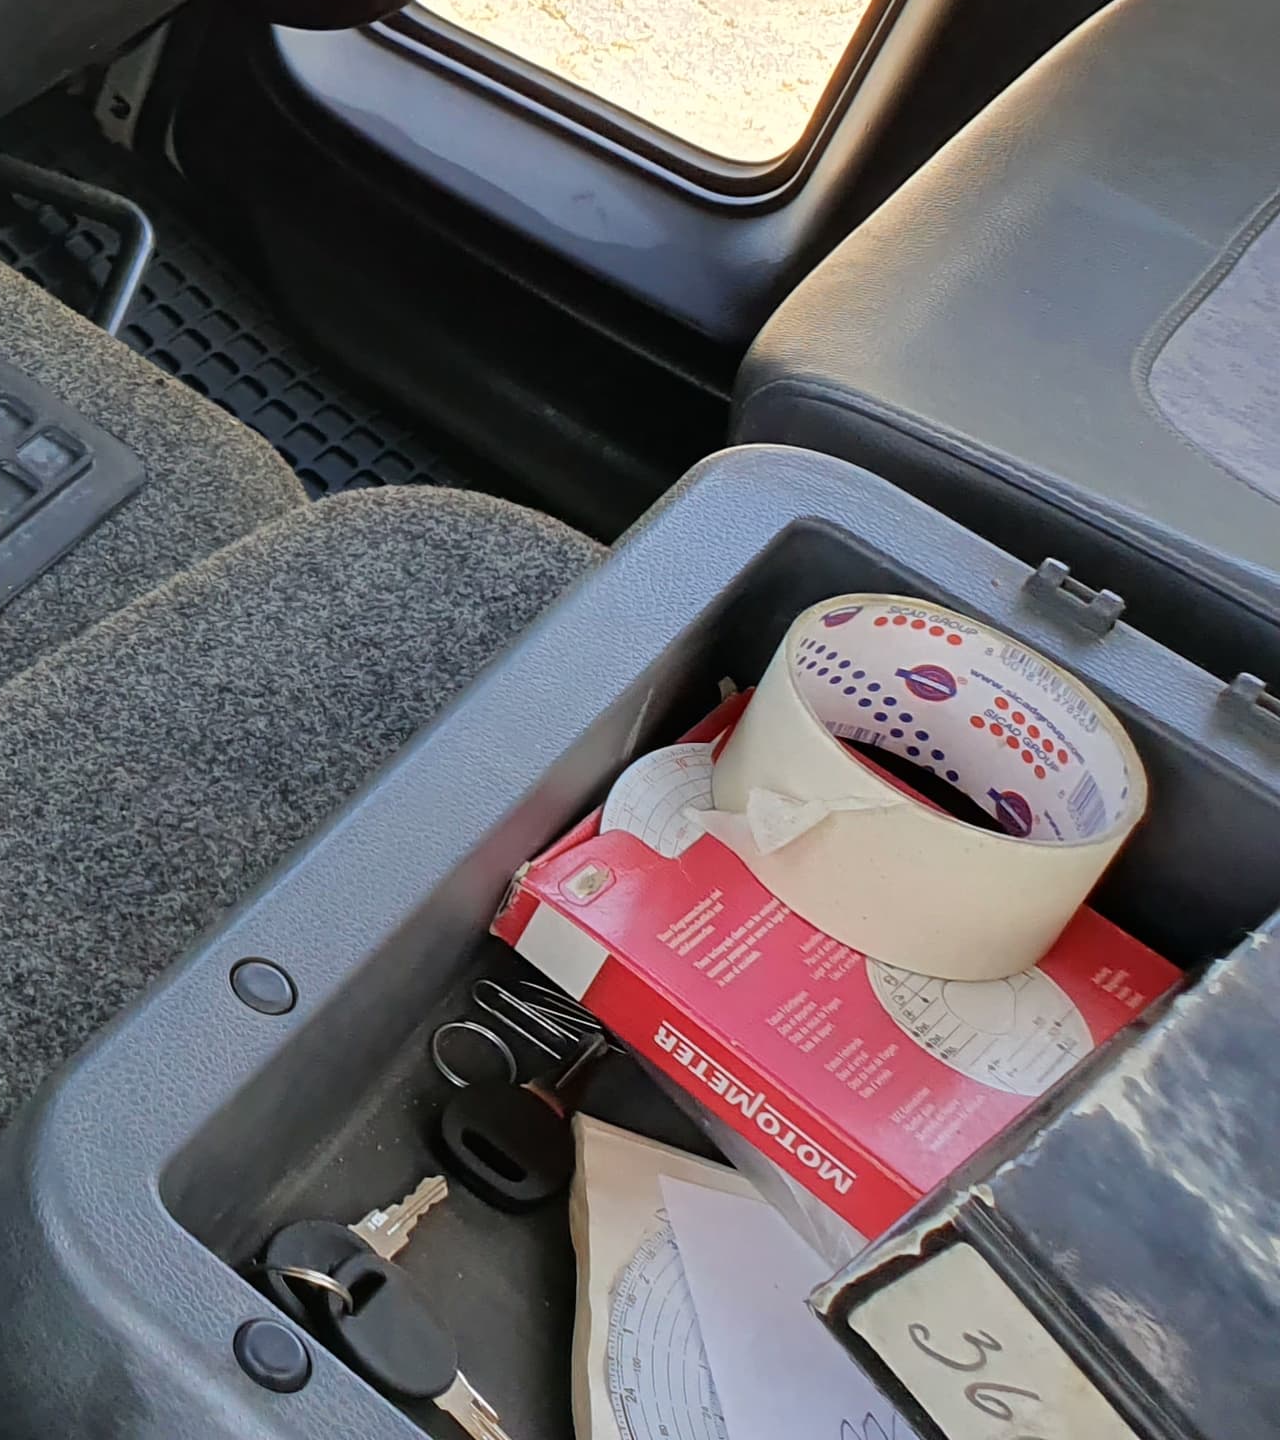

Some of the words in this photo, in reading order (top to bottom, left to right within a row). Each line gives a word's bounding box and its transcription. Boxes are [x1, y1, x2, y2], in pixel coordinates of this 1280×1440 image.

[969, 668, 1086, 766] www.sicadgroup.com
[983, 708, 1022, 737] SICAD
[1022, 736, 1061, 773] GROUP
[653, 1023, 855, 1195] MOTOMETER
[624, 1386, 639, 1405] 24
[908, 1323, 1046, 1440] 36
